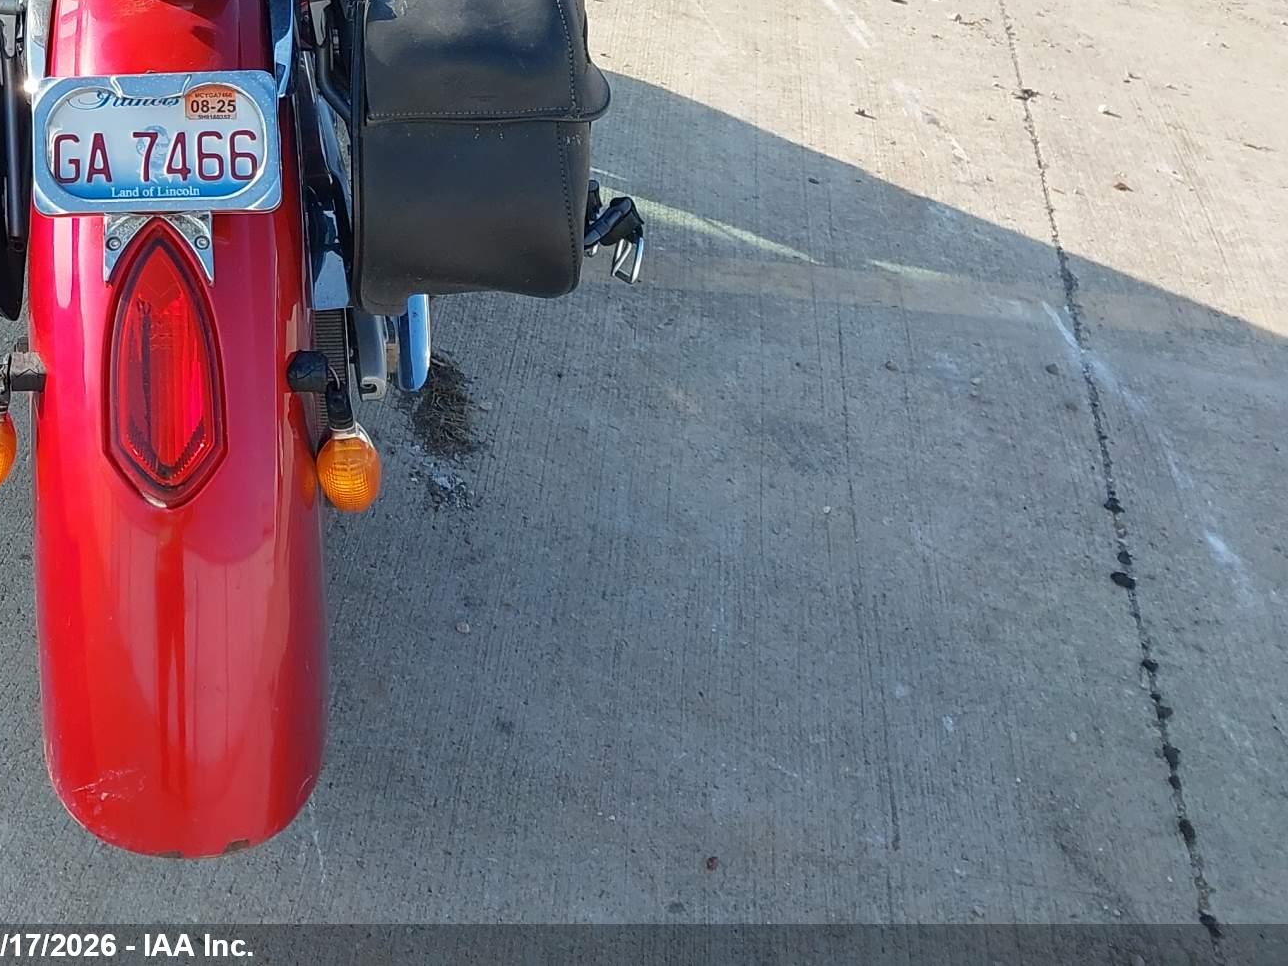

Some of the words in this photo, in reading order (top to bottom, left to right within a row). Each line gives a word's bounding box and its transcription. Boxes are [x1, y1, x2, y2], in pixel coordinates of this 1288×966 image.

[190, 99, 236, 113] 08-25
[53, 133, 113, 184] GA
[132, 129, 258, 183] 7466
[111, 186, 140, 198] Land
[142, 186, 155, 198] of
[157, 186, 200, 198] Lincoln
